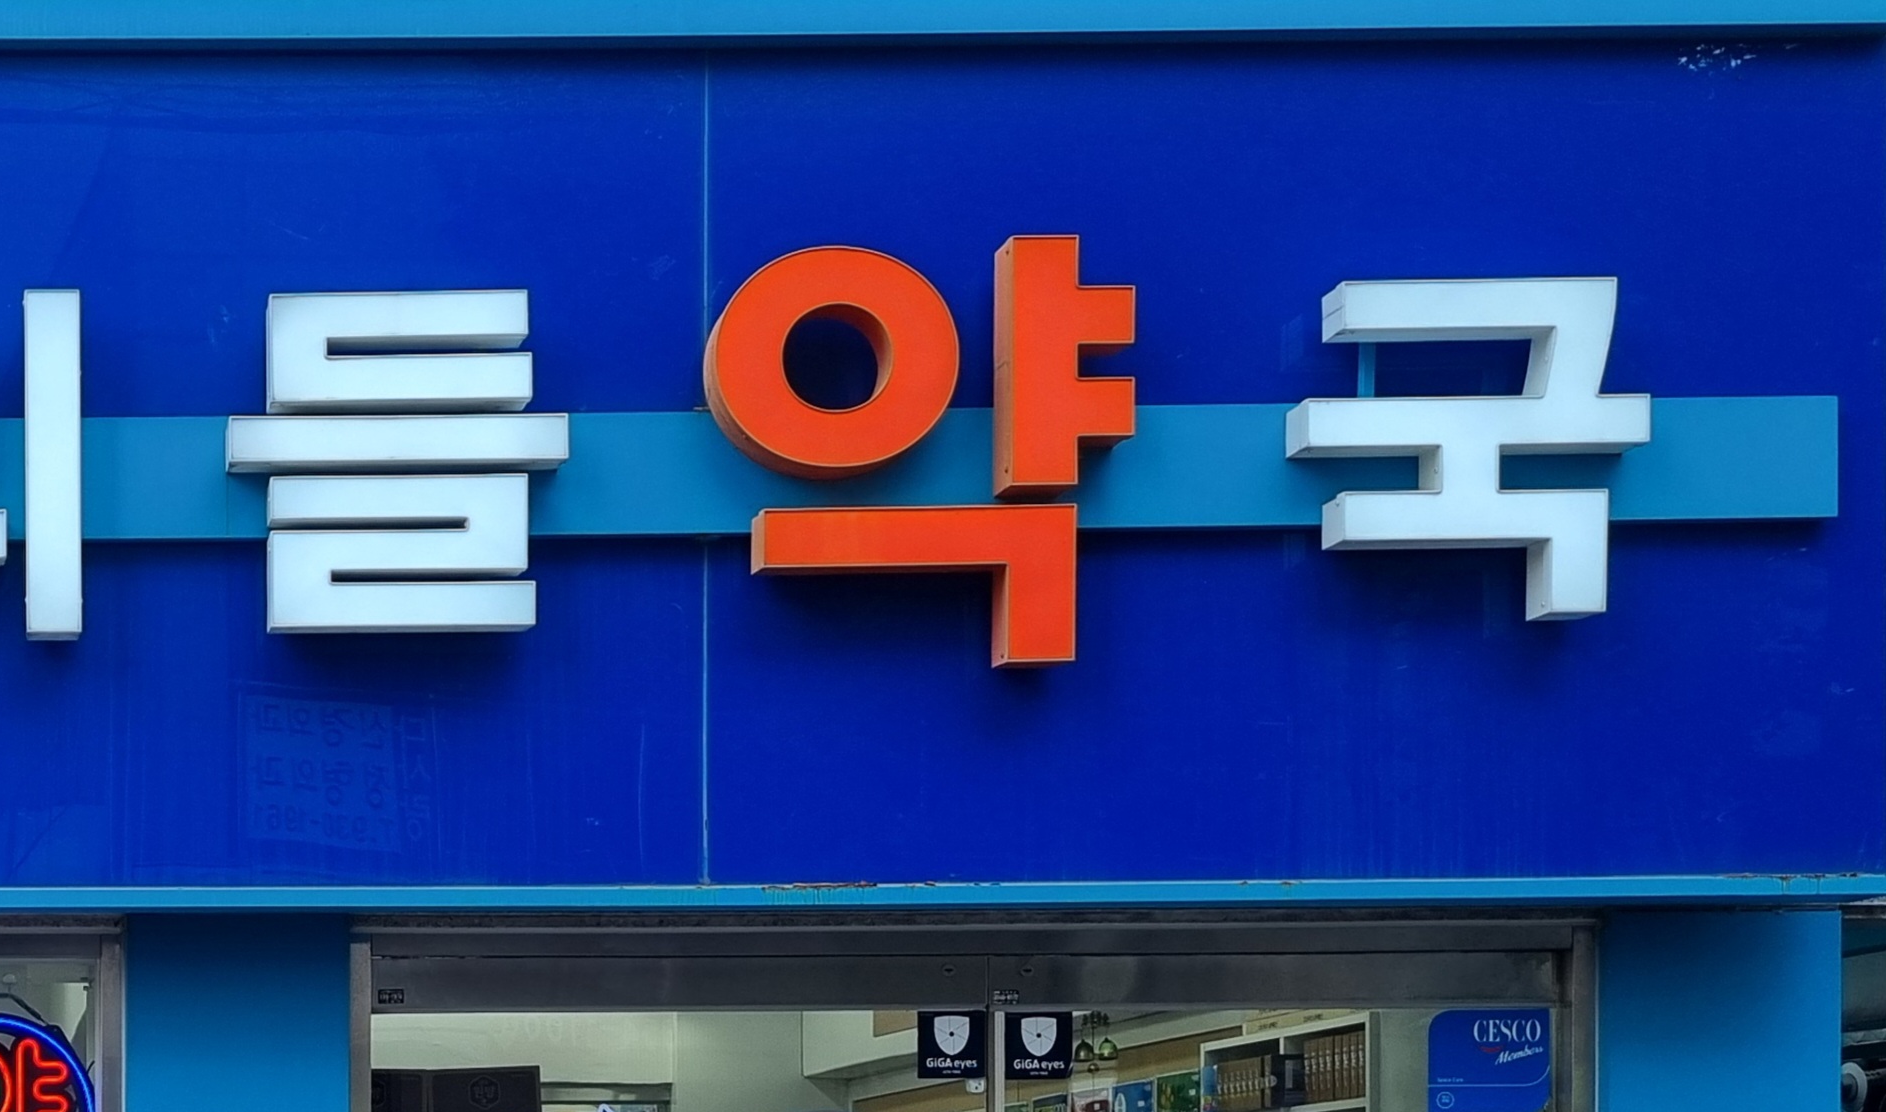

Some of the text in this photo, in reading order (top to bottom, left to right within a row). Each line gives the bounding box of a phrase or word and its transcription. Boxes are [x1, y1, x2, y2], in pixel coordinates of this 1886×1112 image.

[1474, 1019, 1541, 1042] CESCO
[1495, 1044, 1544, 1065] Members
[926, 1058, 977, 1069] GiGA eyes
[1014, 1059, 1064, 1070] GiGA eyes
